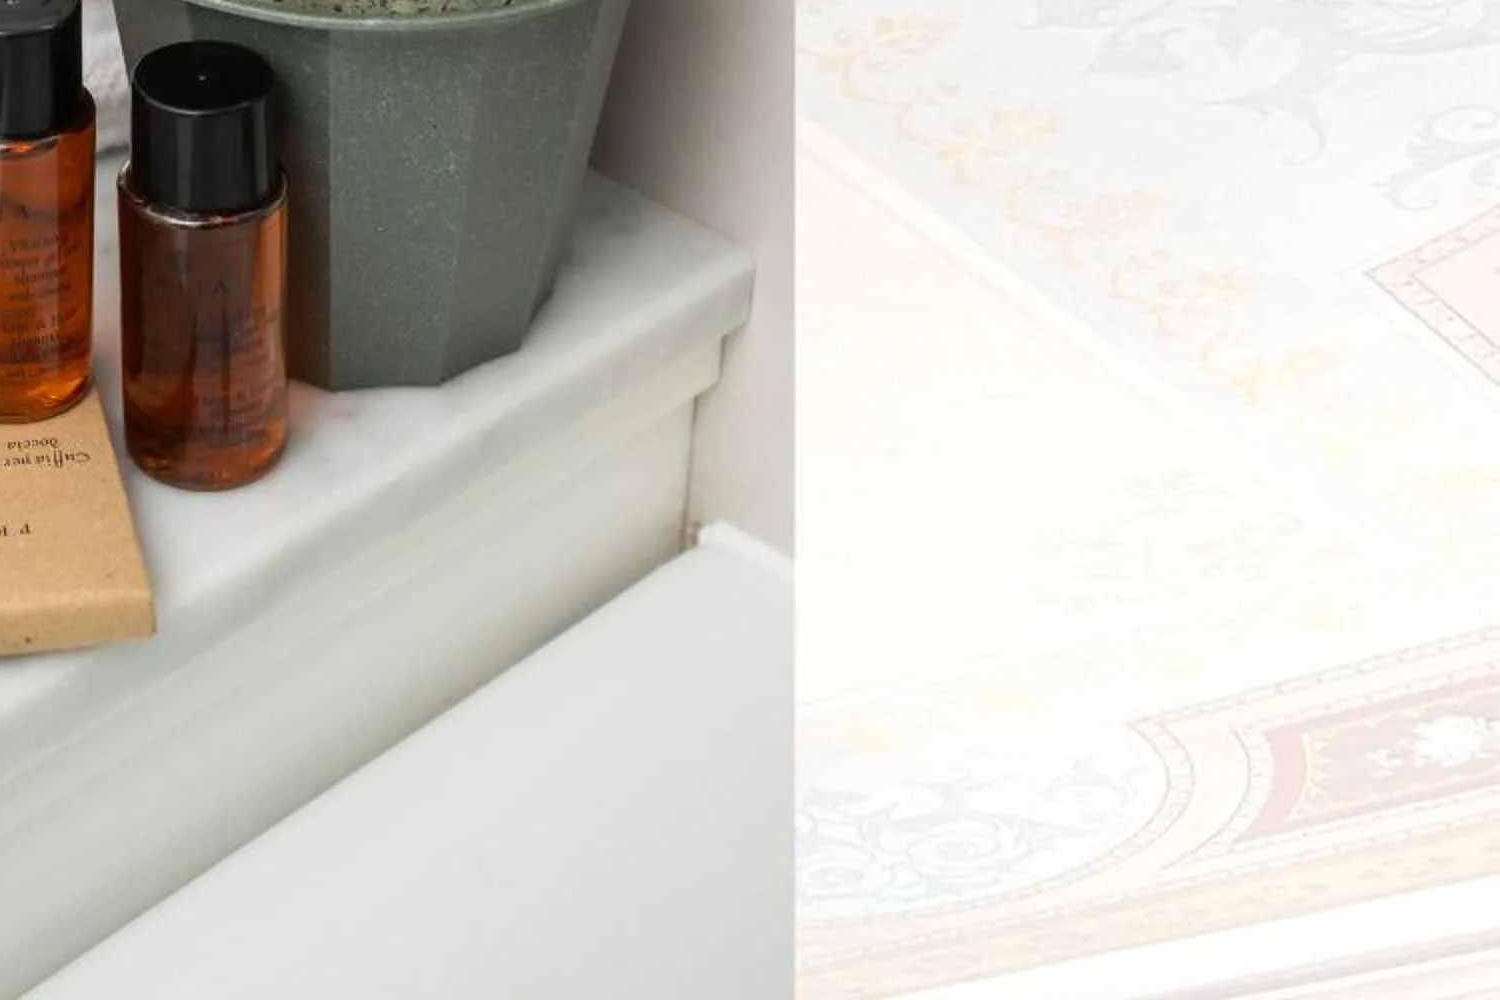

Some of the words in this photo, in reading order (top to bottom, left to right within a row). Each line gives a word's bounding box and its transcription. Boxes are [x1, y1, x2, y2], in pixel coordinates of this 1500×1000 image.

[6, 437, 59, 453] doccia
[3, 453, 32, 468] per
[34, 450, 92, 469] Cuffia
